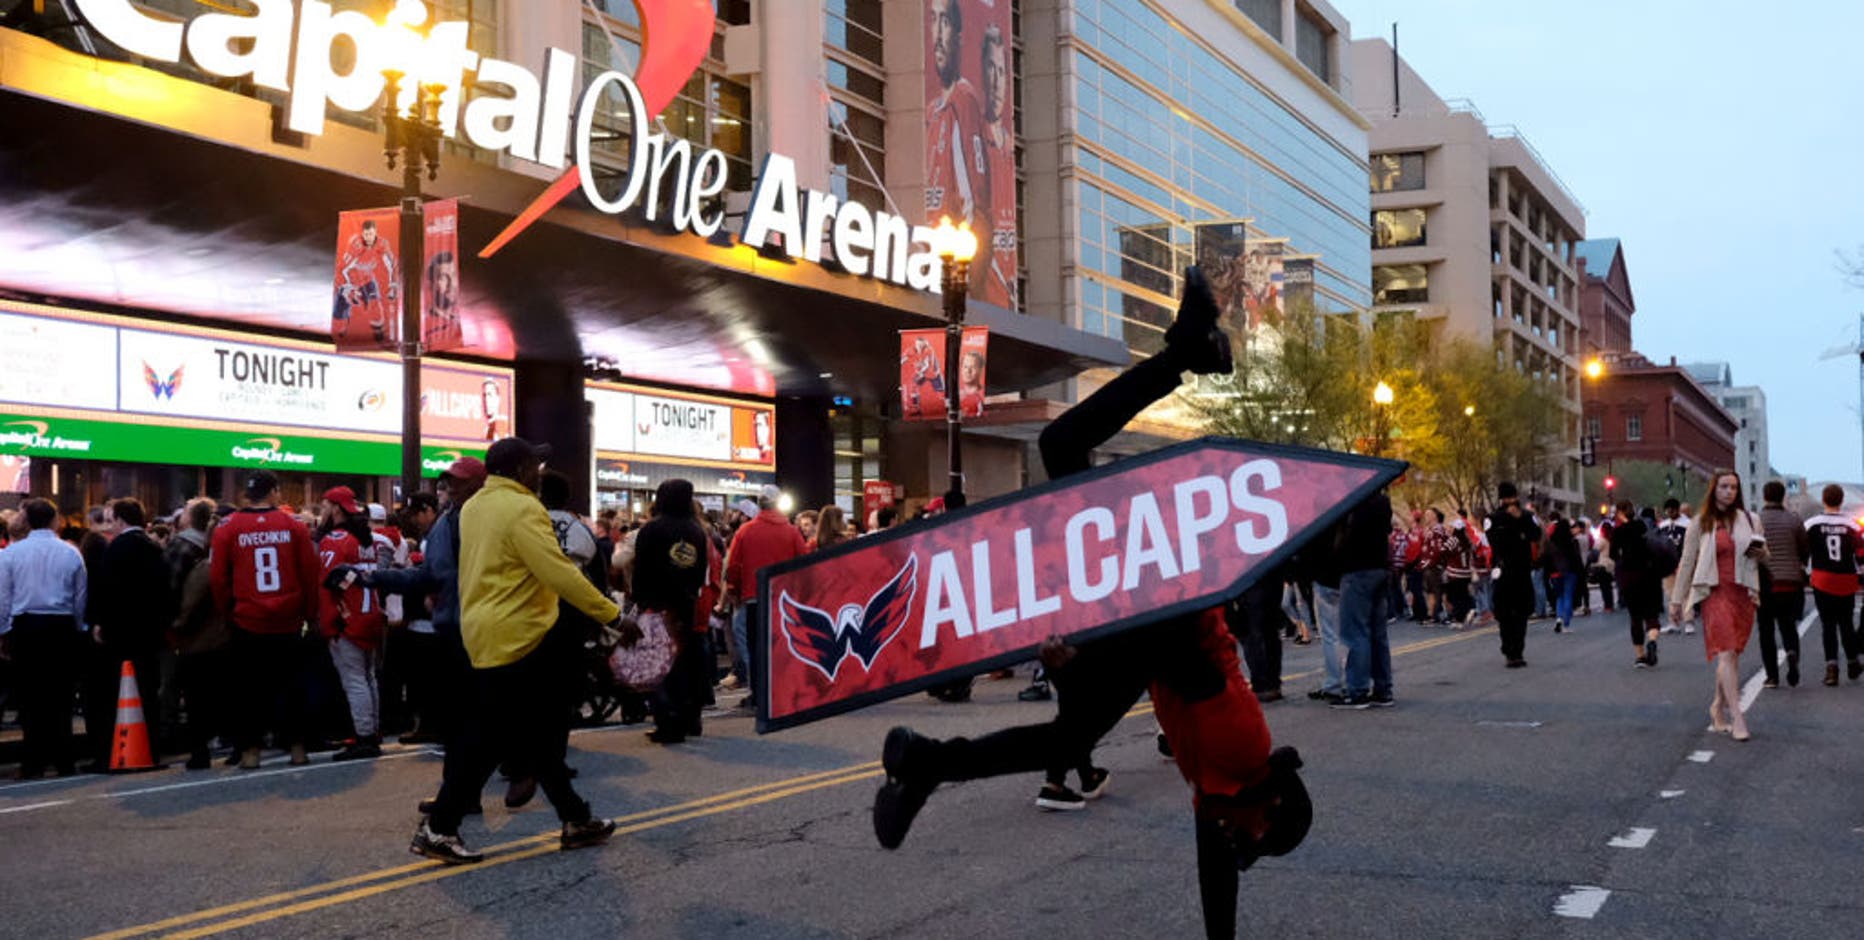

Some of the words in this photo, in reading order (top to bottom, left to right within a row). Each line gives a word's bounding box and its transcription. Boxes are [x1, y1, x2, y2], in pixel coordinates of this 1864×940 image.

[741, 152, 944, 294] Arena
[214, 347, 330, 391] TONIGHT
[651, 402, 717, 432] TONIGHT
[238, 530, 291, 547] OVECHKIN
[919, 526, 1062, 649] ALL
[1064, 457, 1289, 603] CAPS
[254, 546, 281, 593] 8
